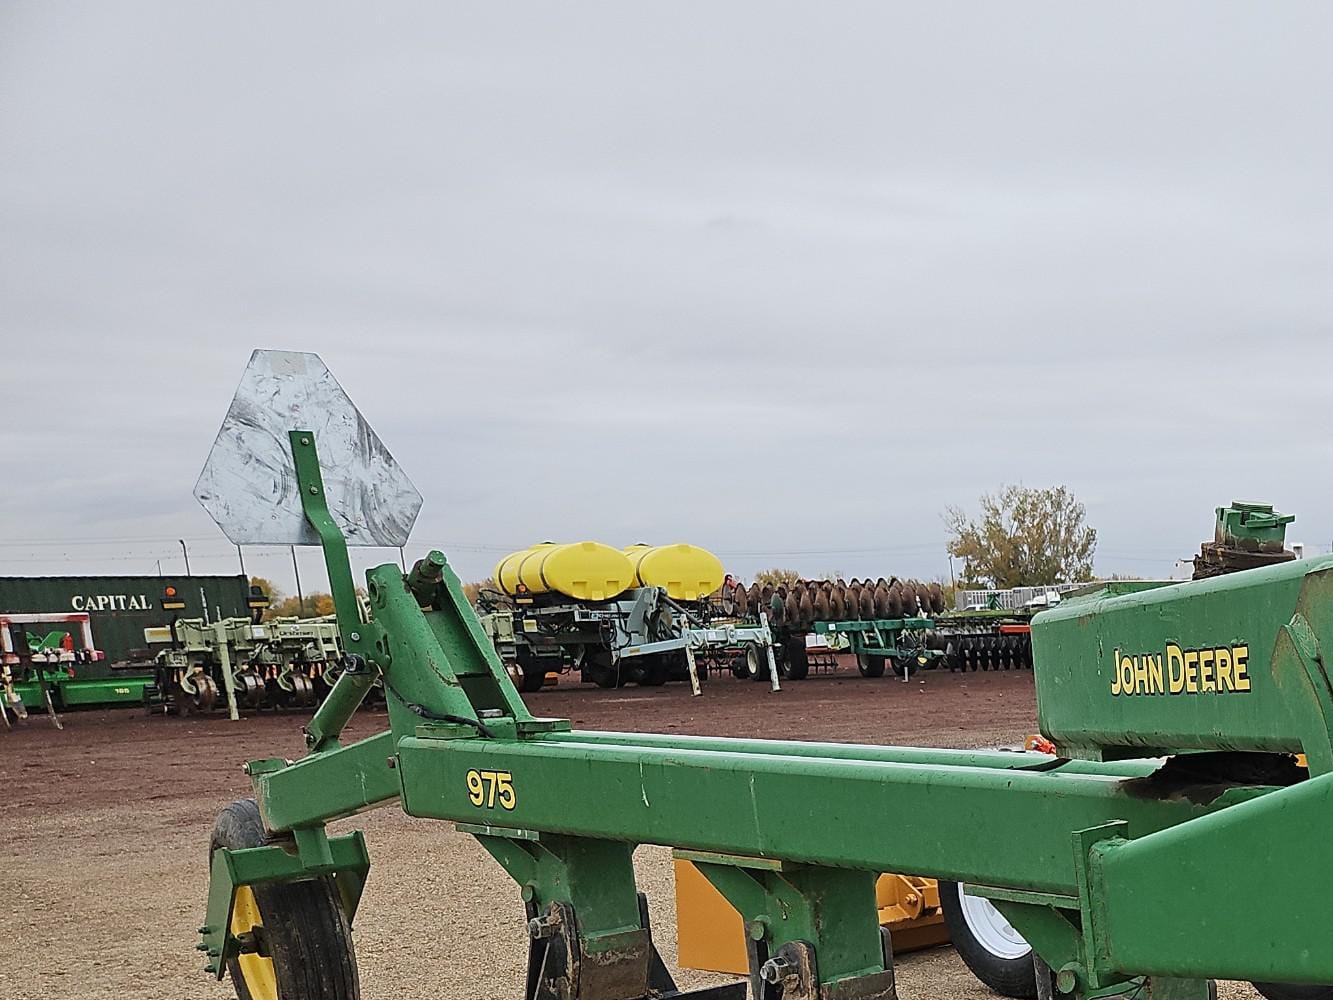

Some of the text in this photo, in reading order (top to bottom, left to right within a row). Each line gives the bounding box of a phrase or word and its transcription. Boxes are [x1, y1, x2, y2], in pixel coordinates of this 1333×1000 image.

[71, 594, 153, 611] CAPITAL
[1111, 640, 1252, 696] JOHN DEERE
[465, 767, 517, 811] 975
